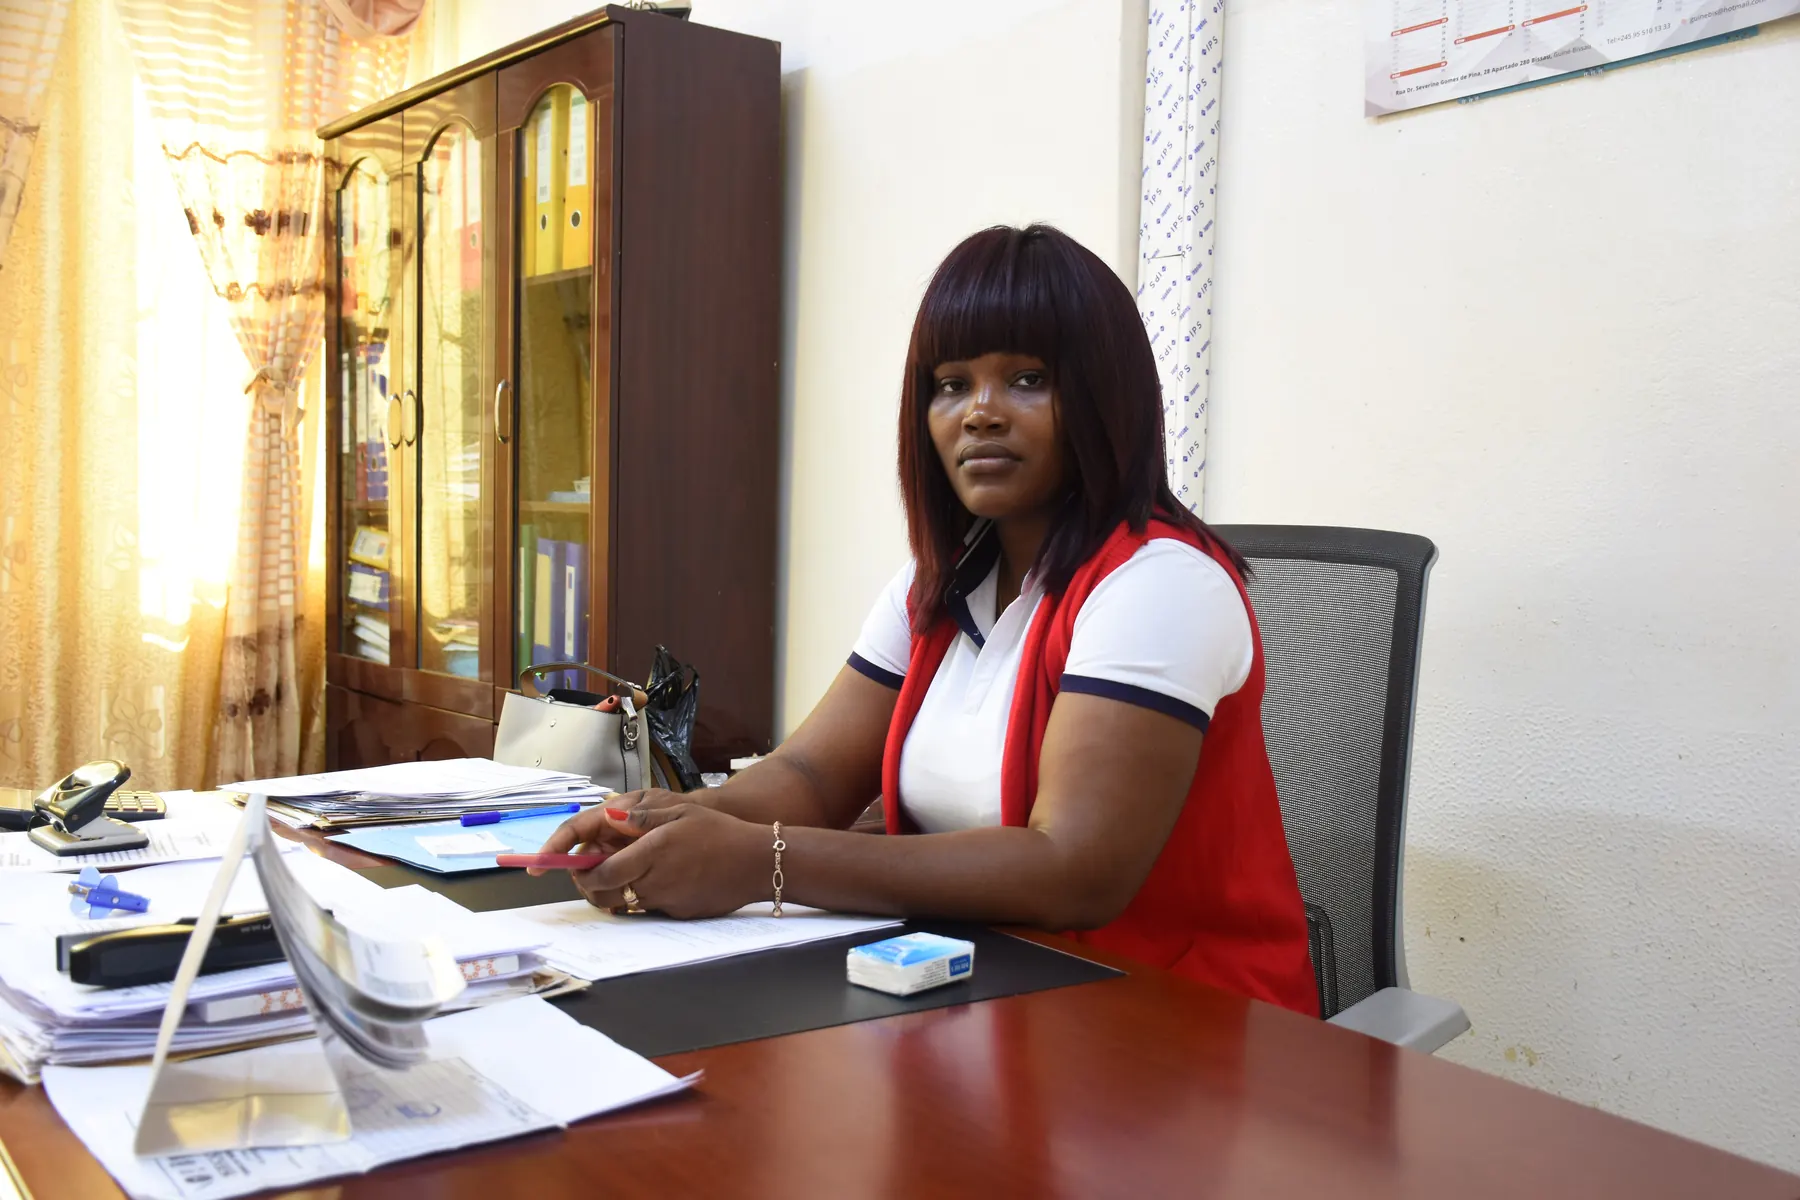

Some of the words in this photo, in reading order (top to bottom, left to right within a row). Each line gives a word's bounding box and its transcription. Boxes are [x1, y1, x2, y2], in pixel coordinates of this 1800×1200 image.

[1163, 23, 1175, 41] IPS
[1206, 36, 1218, 52] IPS
[1407, 86, 1415, 94] Dr.
[1440, 76, 1459, 85] Gomes
[1491, 62, 1519, 74] Apartado
[1531, 54, 1553, 63] Bissau,
[1193, 78, 1207, 95] IPS
[1172, 95, 1184, 113] IPS
[1161, 141, 1173, 159] IPS
[1204, 157, 1216, 173] IPS
[1149, 188, 1162, 206] IPS
[1191, 200, 1205, 216] IPS
[1201, 278, 1213, 294] IPS
[1189, 320, 1202, 337] IPS
[1177, 364, 1191, 381] IPS
[1187, 441, 1200, 457] IPS
